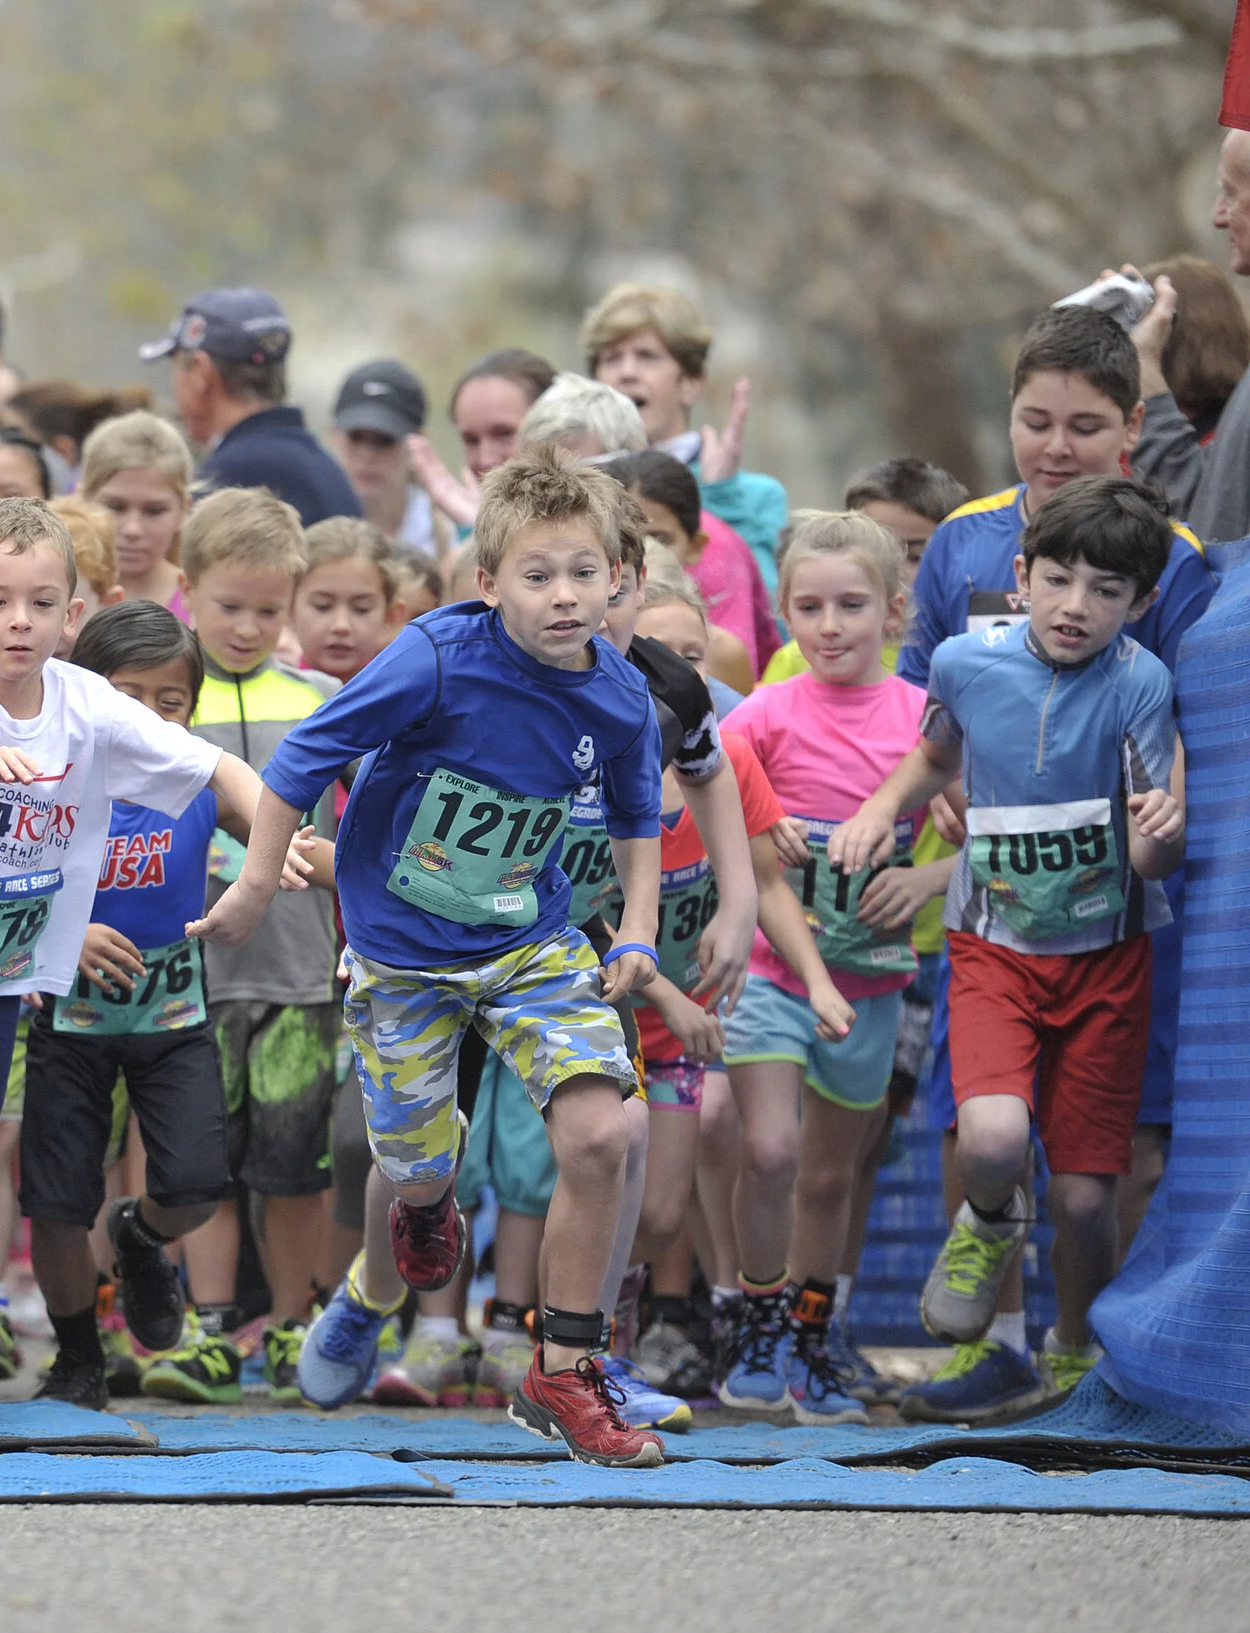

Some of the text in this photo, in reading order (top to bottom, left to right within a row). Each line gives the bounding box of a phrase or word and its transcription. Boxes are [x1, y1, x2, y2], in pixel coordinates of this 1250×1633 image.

[445, 774, 481, 795] EXPLORE
[496, 790, 527, 804] INSPIRE
[432, 791, 563, 859] 1219
[96, 853, 166, 891] USA
